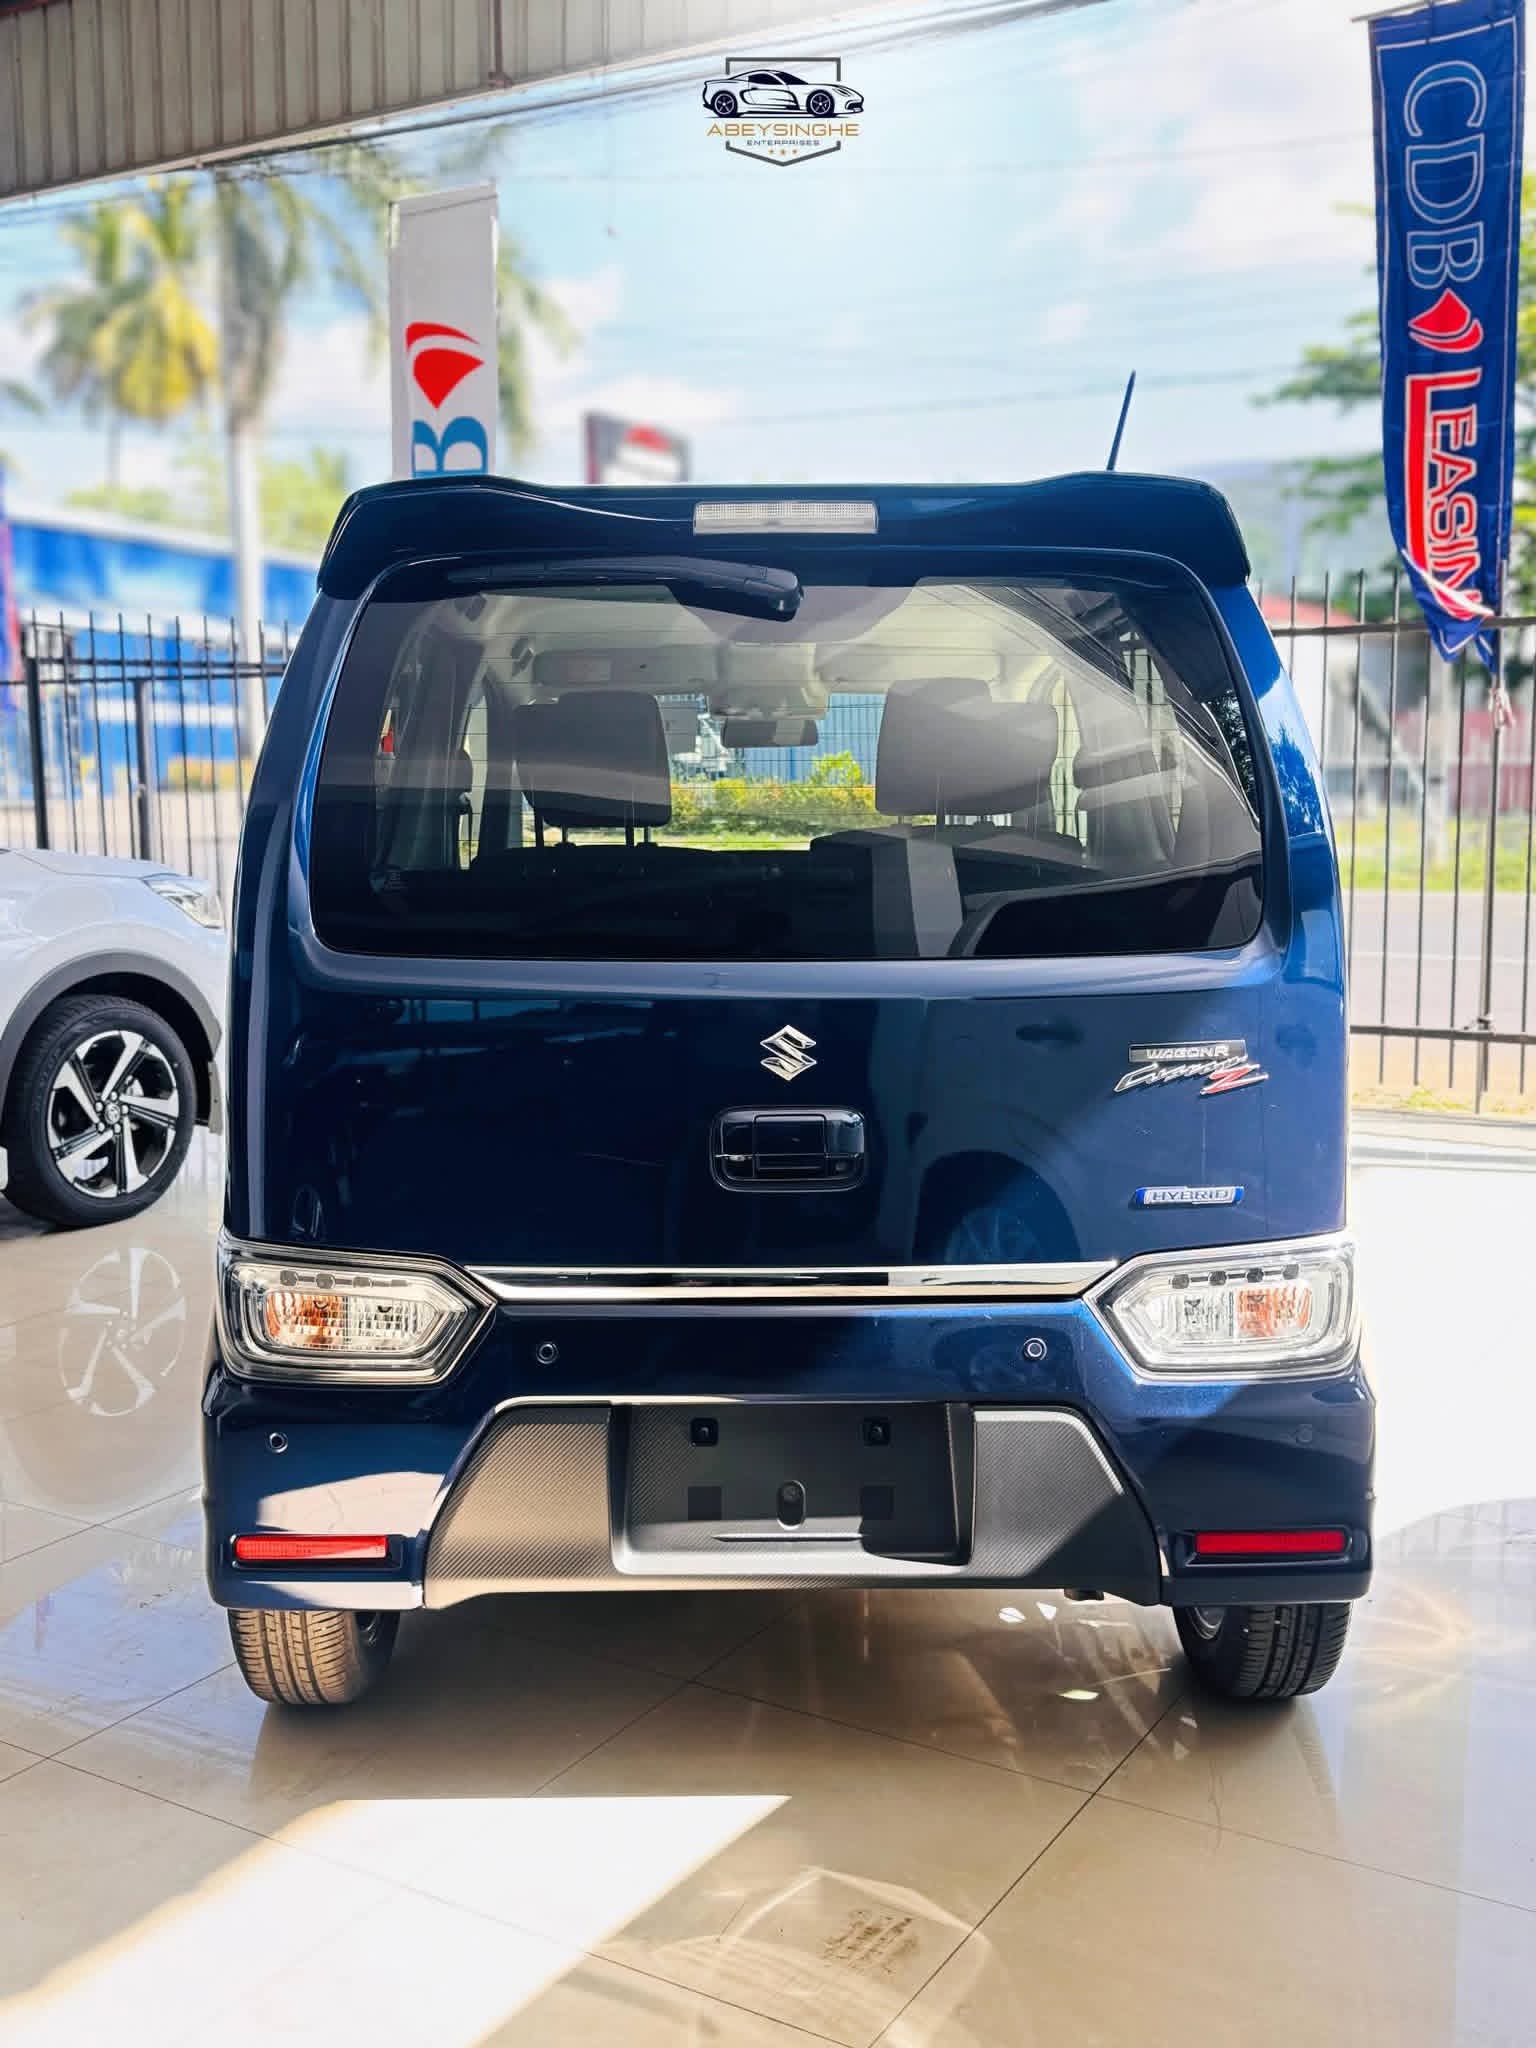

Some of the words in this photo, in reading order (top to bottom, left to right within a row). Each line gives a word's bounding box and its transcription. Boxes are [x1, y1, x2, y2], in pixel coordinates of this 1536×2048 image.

[1403, 60, 1487, 290] CDB
[1404, 368, 1483, 608] LEASIN
[1152, 1189, 1229, 1201] HYBRID
